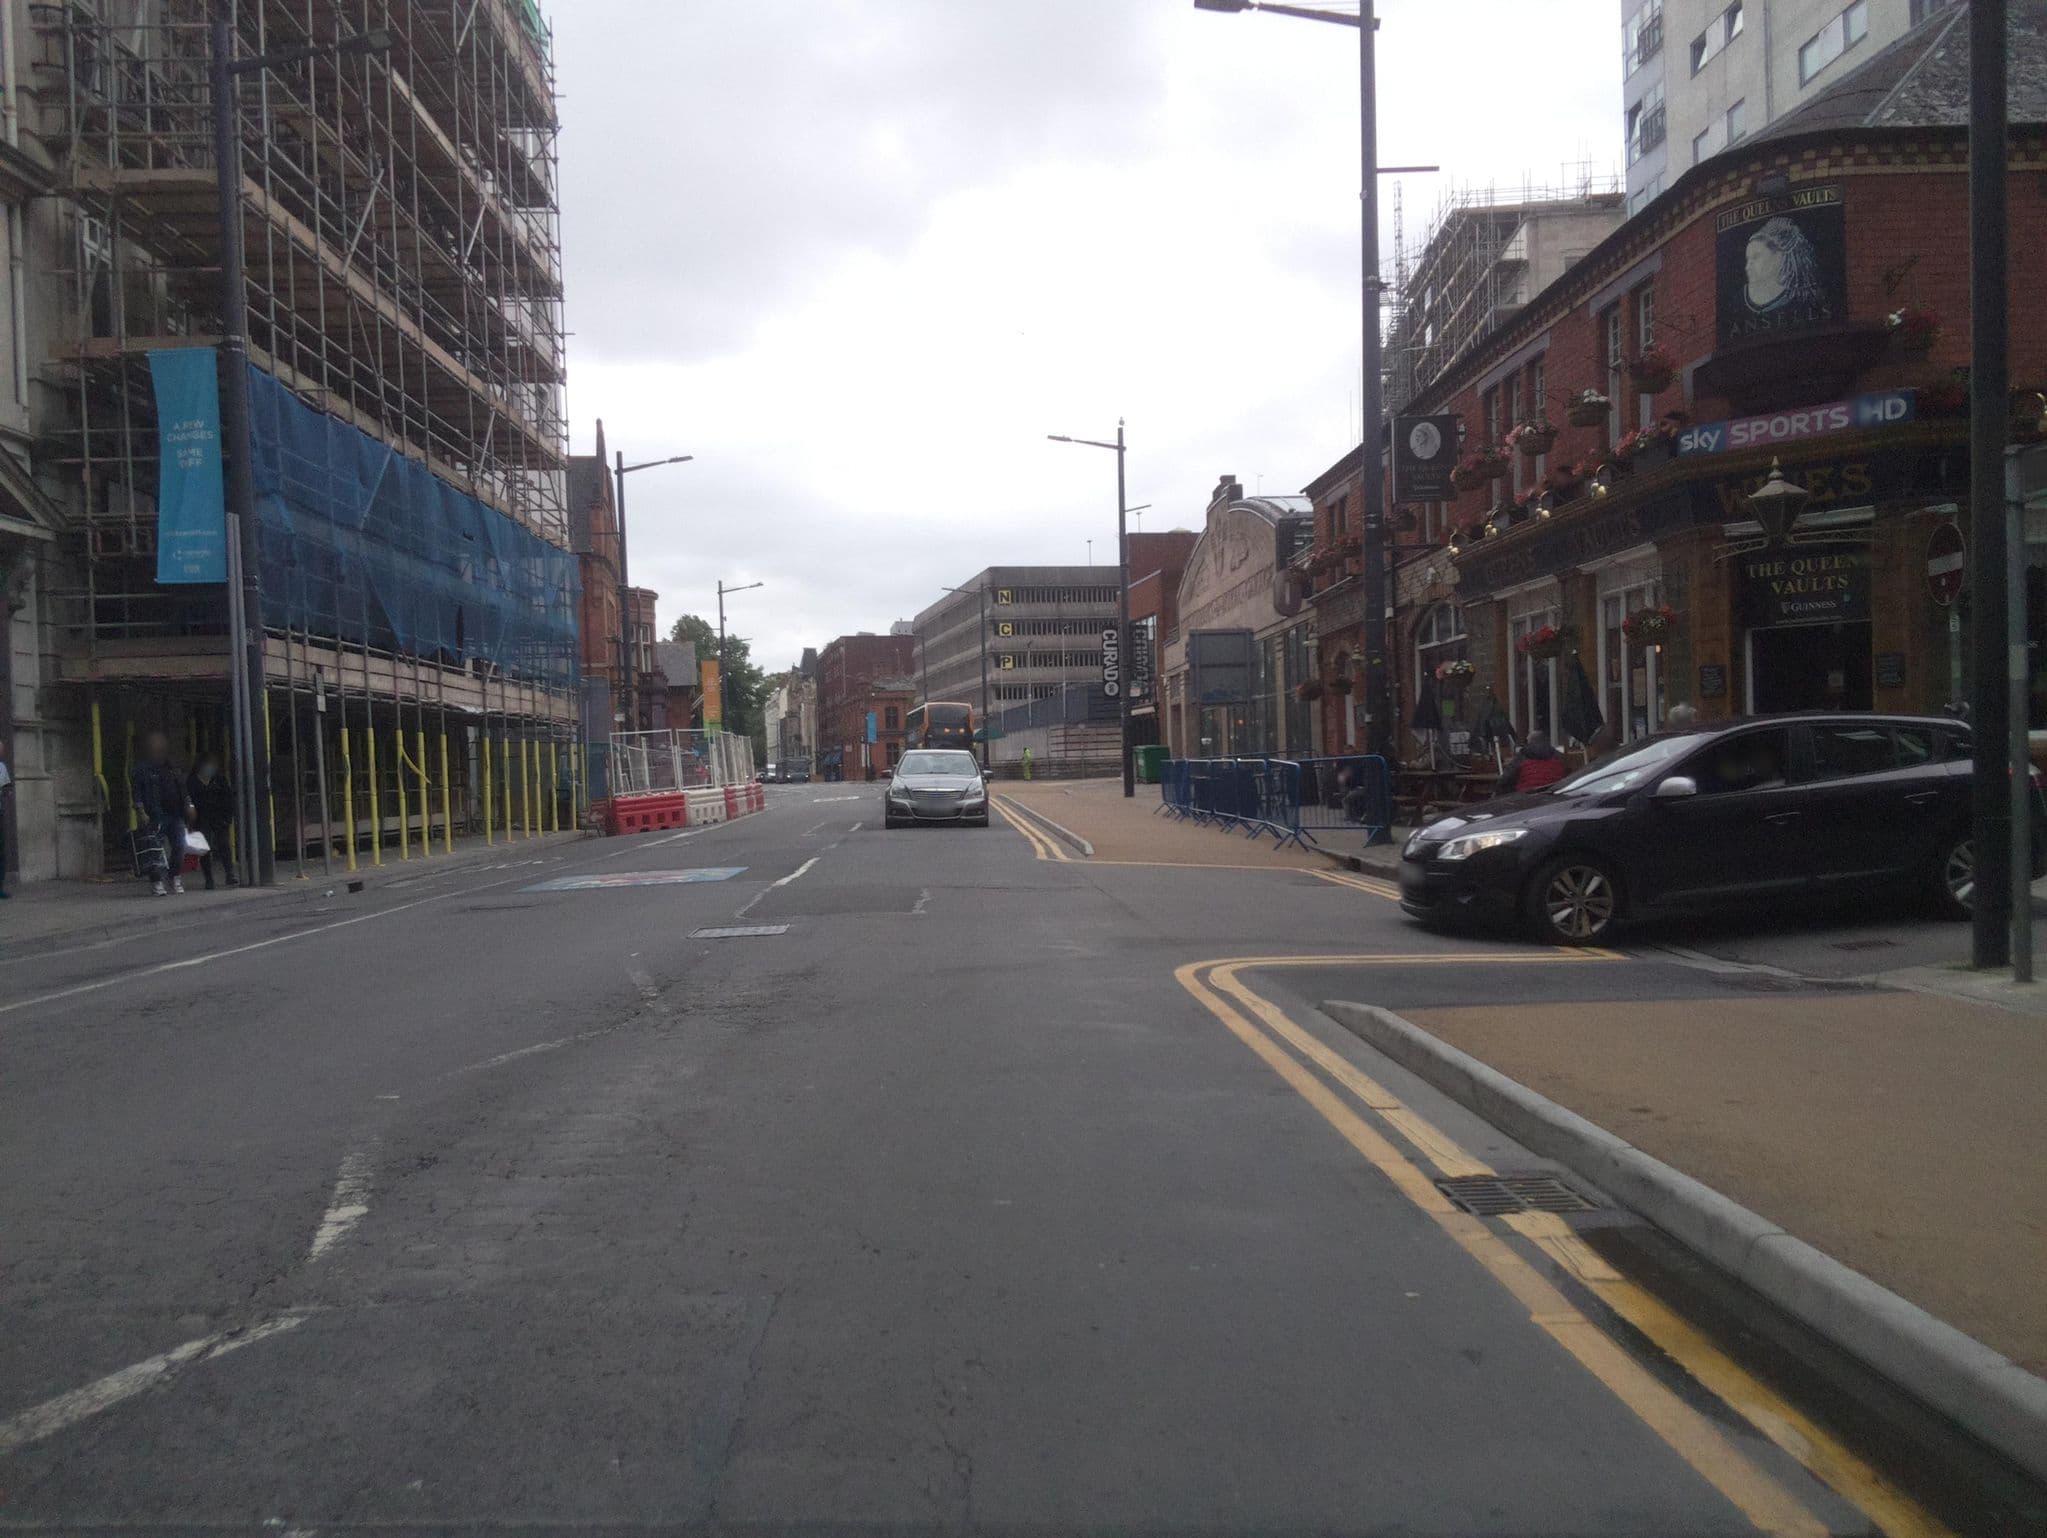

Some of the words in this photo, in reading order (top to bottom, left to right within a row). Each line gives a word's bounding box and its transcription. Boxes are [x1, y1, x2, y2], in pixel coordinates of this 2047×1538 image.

[1721, 210, 1738, 228] THE
[1792, 188, 1837, 206] VAULTS
[1729, 306, 1832, 338] ANSELLS
[1680, 428, 1721, 452] sky
[1730, 405, 1850, 445] SPORTS
[1863, 397, 1908, 422] HD
[1747, 561, 1786, 578] THE
[1771, 574, 1849, 595] VAULTS
[1790, 600, 1838, 612] GUINNESS
